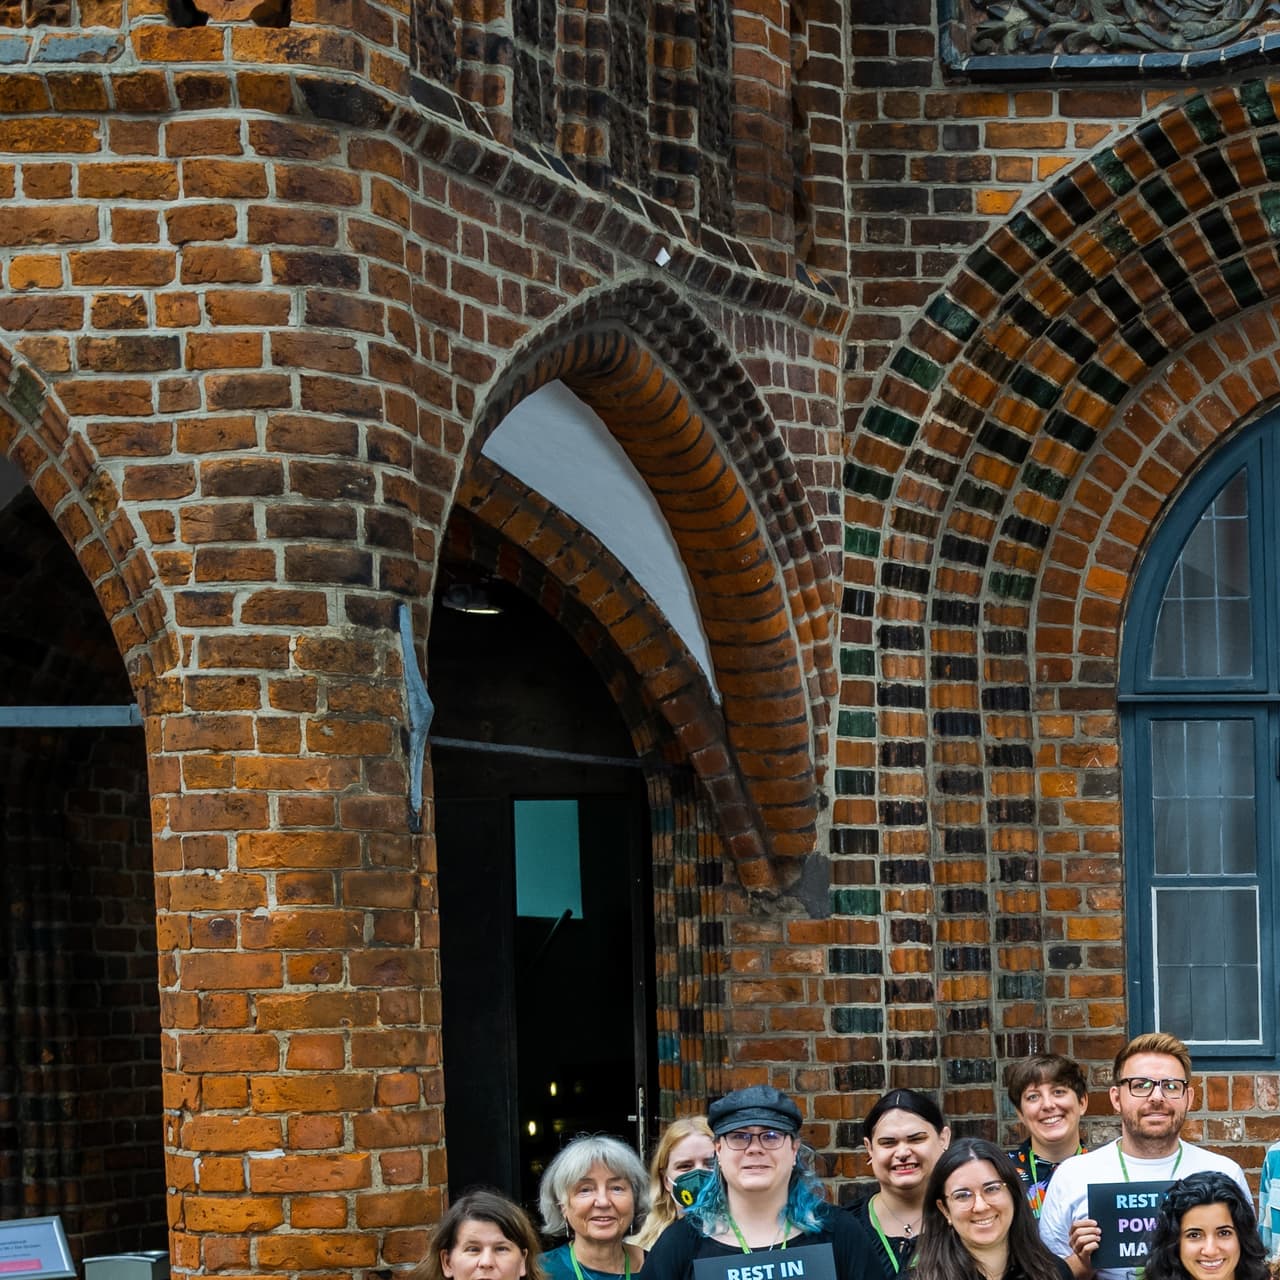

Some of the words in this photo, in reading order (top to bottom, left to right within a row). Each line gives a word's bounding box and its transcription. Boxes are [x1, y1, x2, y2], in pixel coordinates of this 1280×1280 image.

[1116, 1193, 1159, 1209] REST
[1118, 1217, 1158, 1232] POW
[780, 1260, 804, 1278] IN
